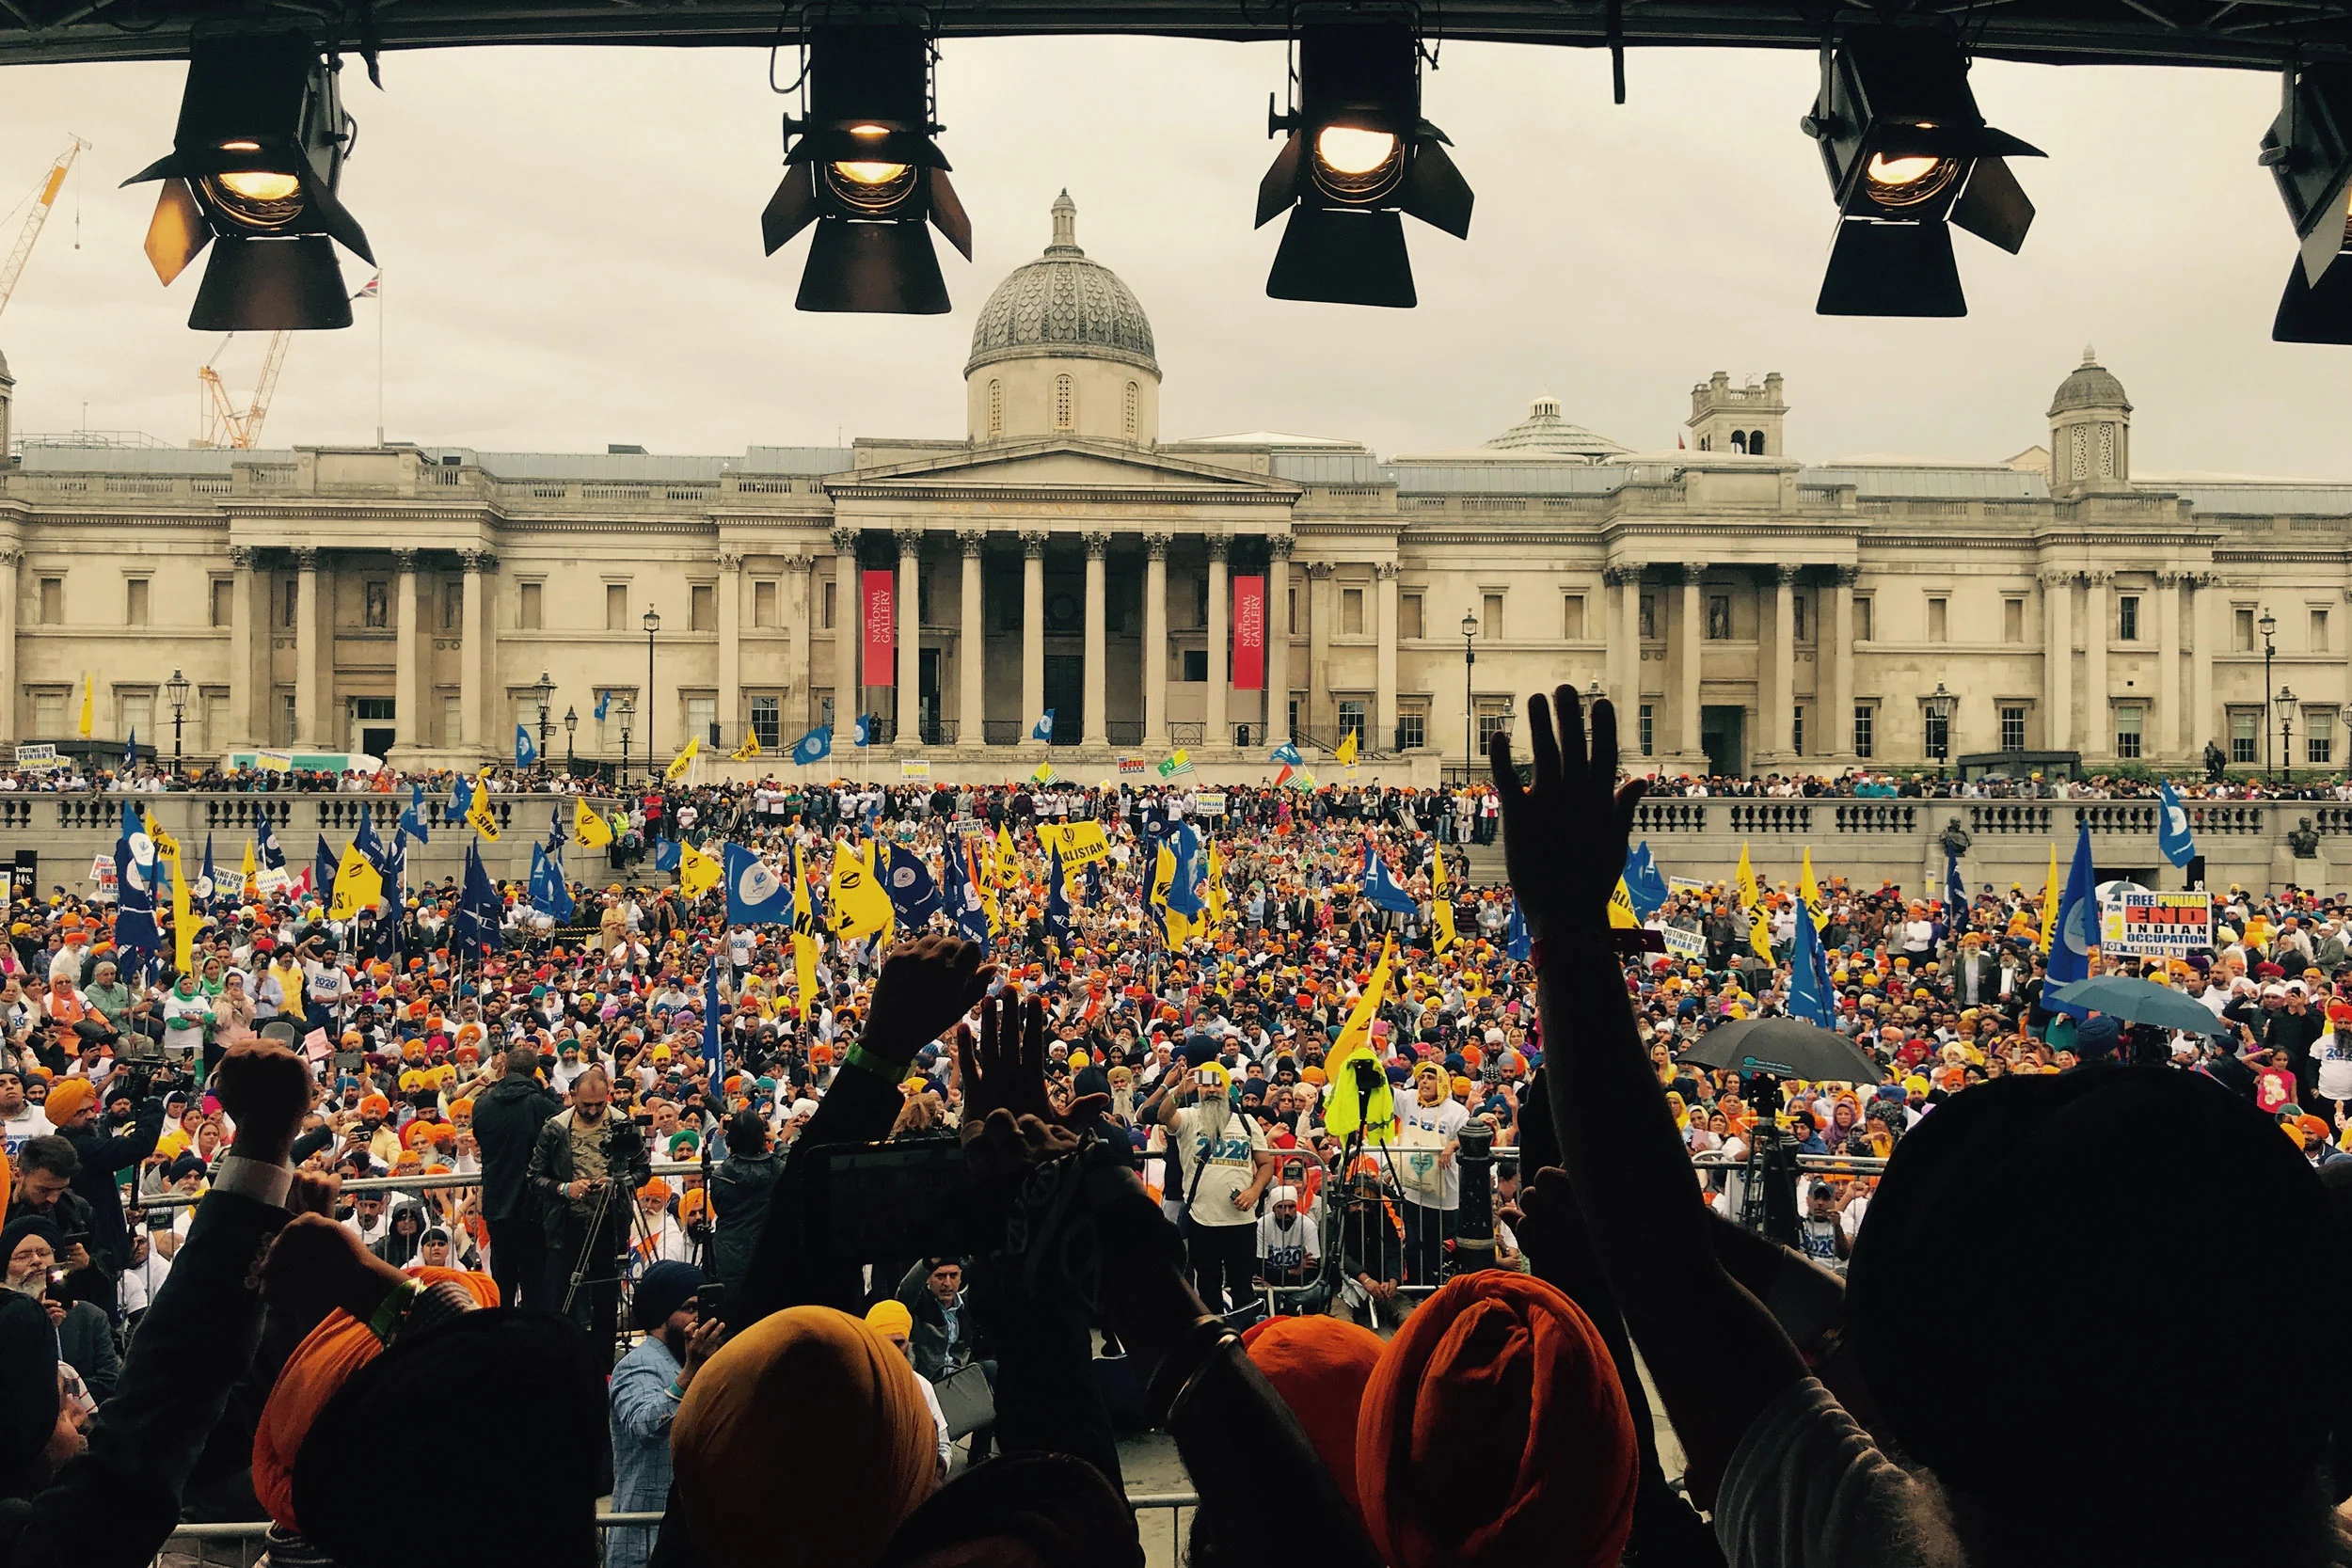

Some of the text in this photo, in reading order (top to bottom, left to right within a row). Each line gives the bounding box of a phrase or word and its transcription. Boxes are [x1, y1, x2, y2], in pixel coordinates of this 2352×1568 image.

[988, 502, 1089, 515] NATIONAL
[872, 590, 881, 642] NATIONAL
[881, 590, 891, 643] GALLERY
[1242, 594, 1251, 647] NATIONAL
[1251, 594, 1261, 647] GALLERY
[230, 873, 244, 883] FOR
[2126, 895, 2207, 908] FREE PUNJAB
[2126, 907, 2207, 924] END
[1663, 927, 1703, 945] VOTING FOR
[2127, 924, 2207, 934] INDIAN
[2127, 934, 2207, 944] OCCUPATION
[2103, 942, 2123, 952] FOR
[315, 975, 338, 989] 2020
[1195, 1137, 1250, 1160] 2020
